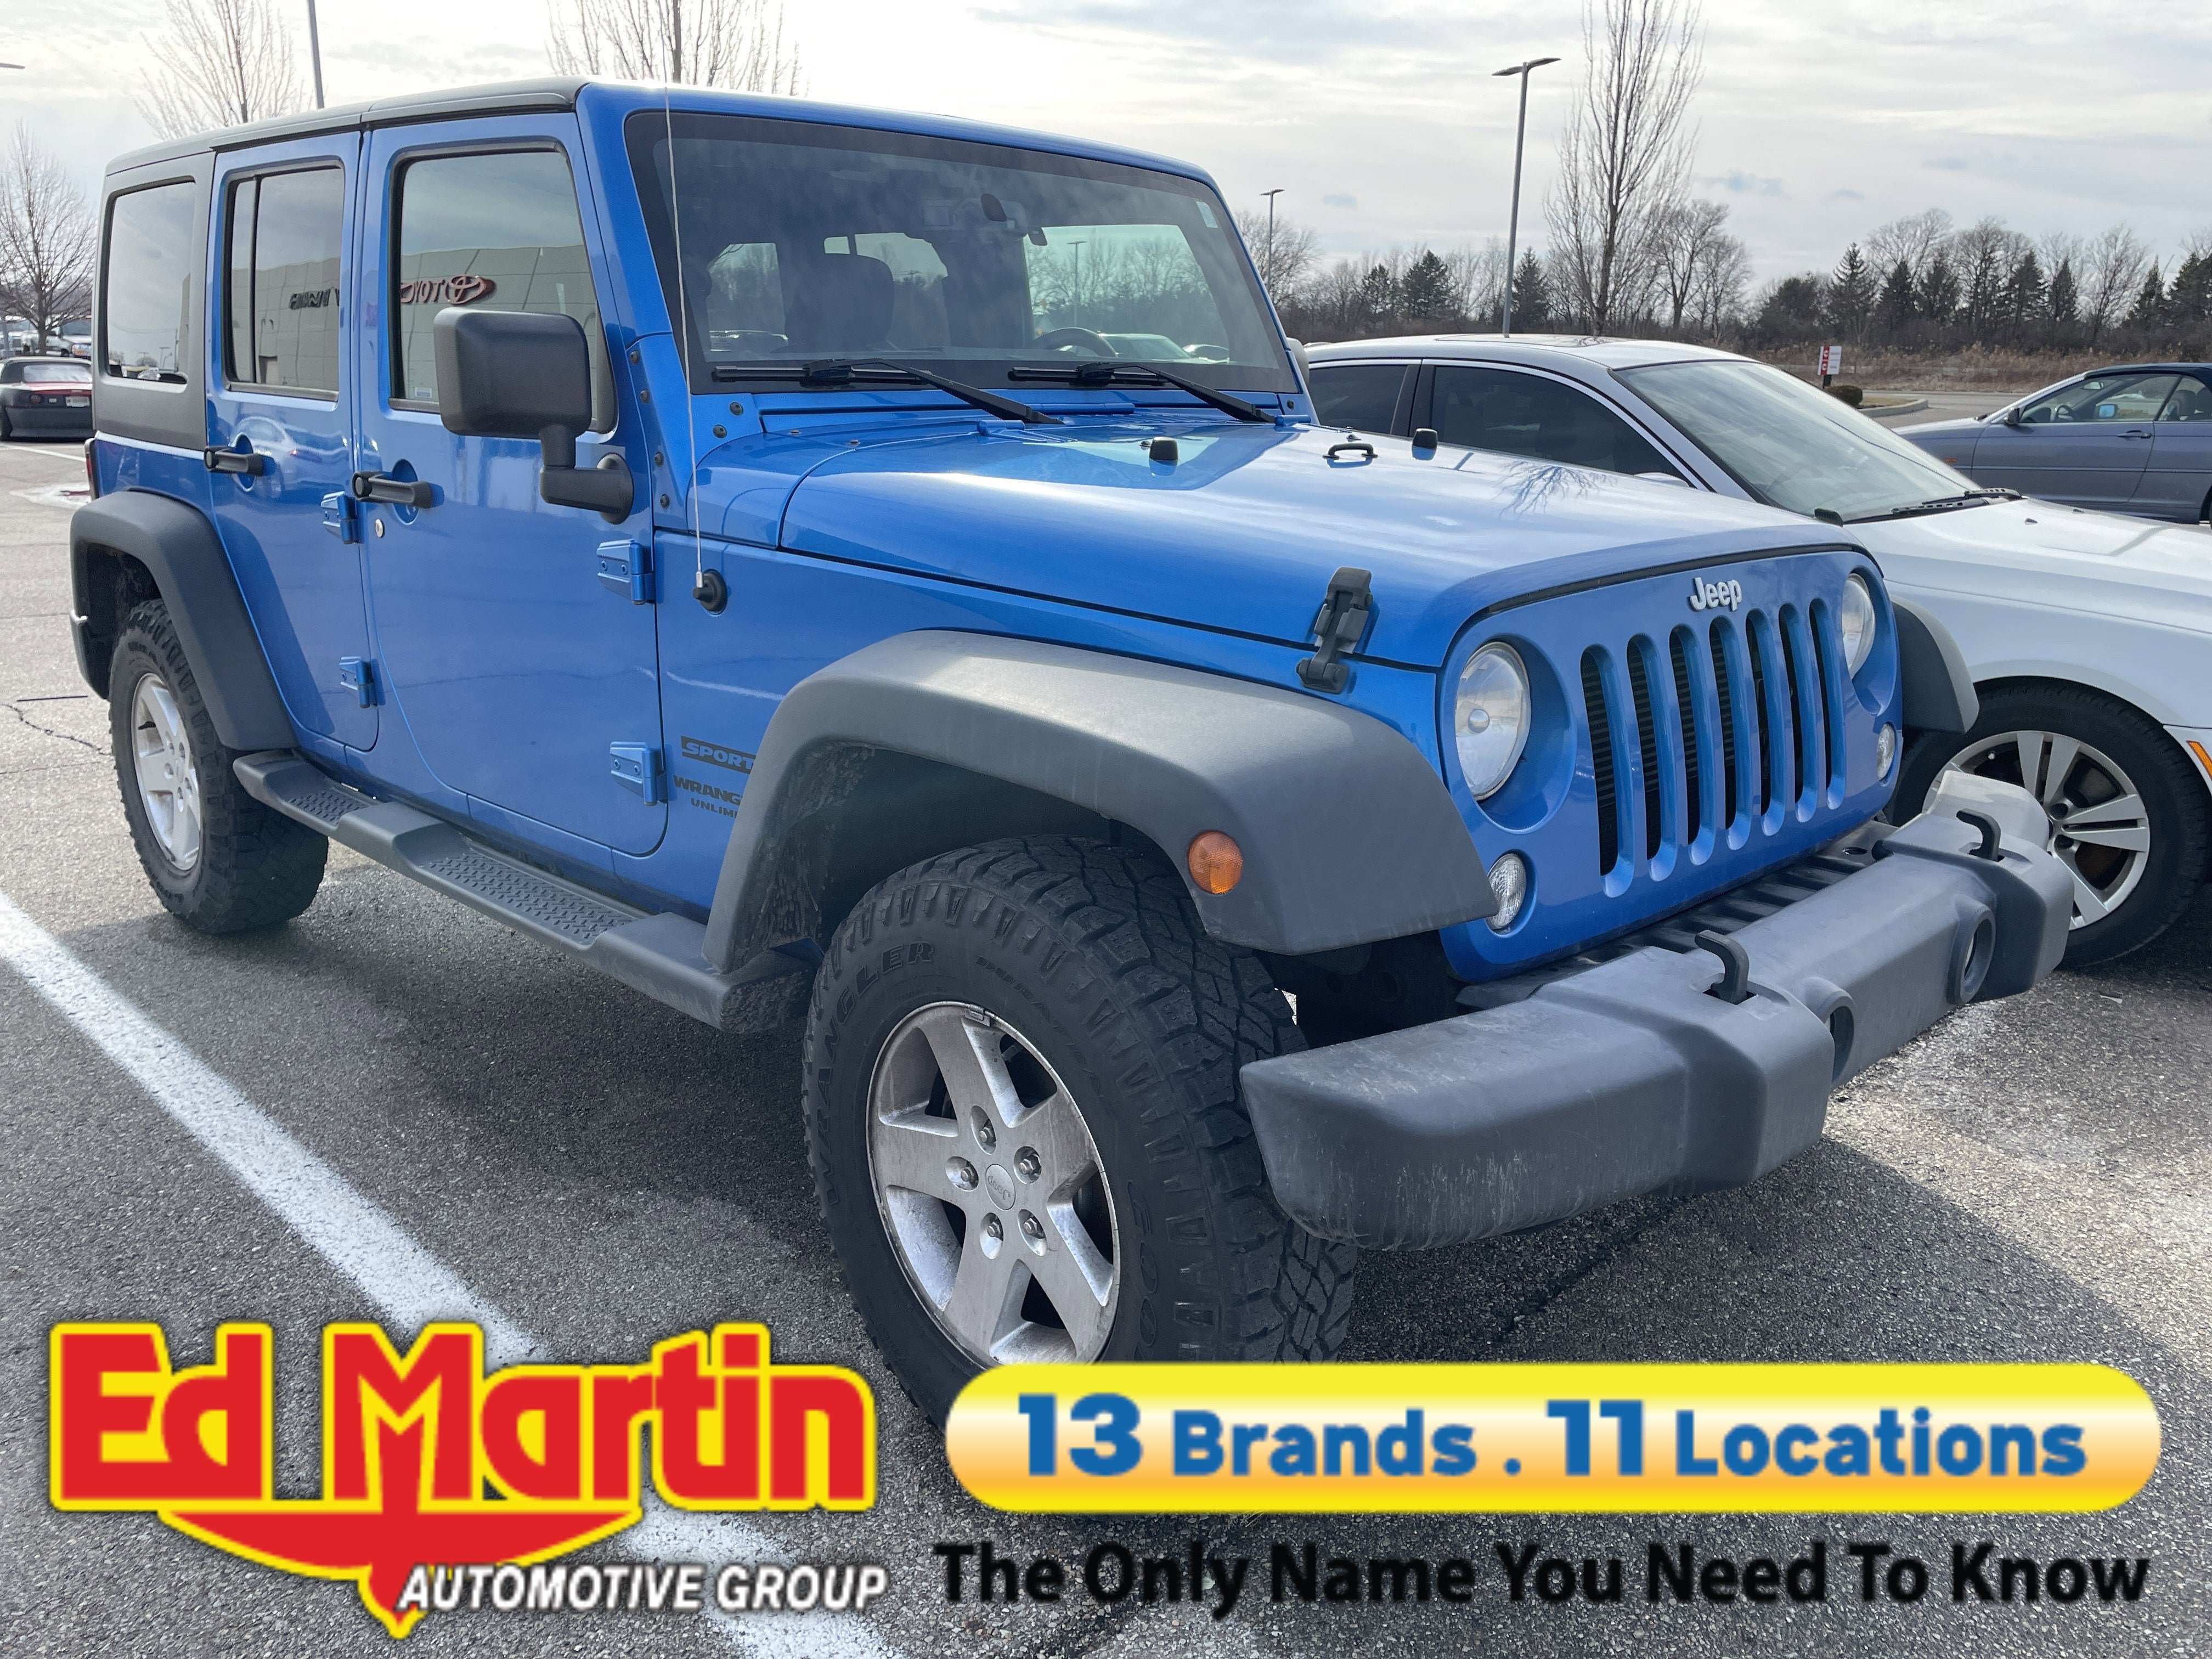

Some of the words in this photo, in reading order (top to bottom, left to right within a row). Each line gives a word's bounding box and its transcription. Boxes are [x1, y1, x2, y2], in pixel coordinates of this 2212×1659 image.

[1688, 577, 1742, 612] Jeep
[686, 742, 755, 770] SPORT
[673, 774, 742, 806] WRANG
